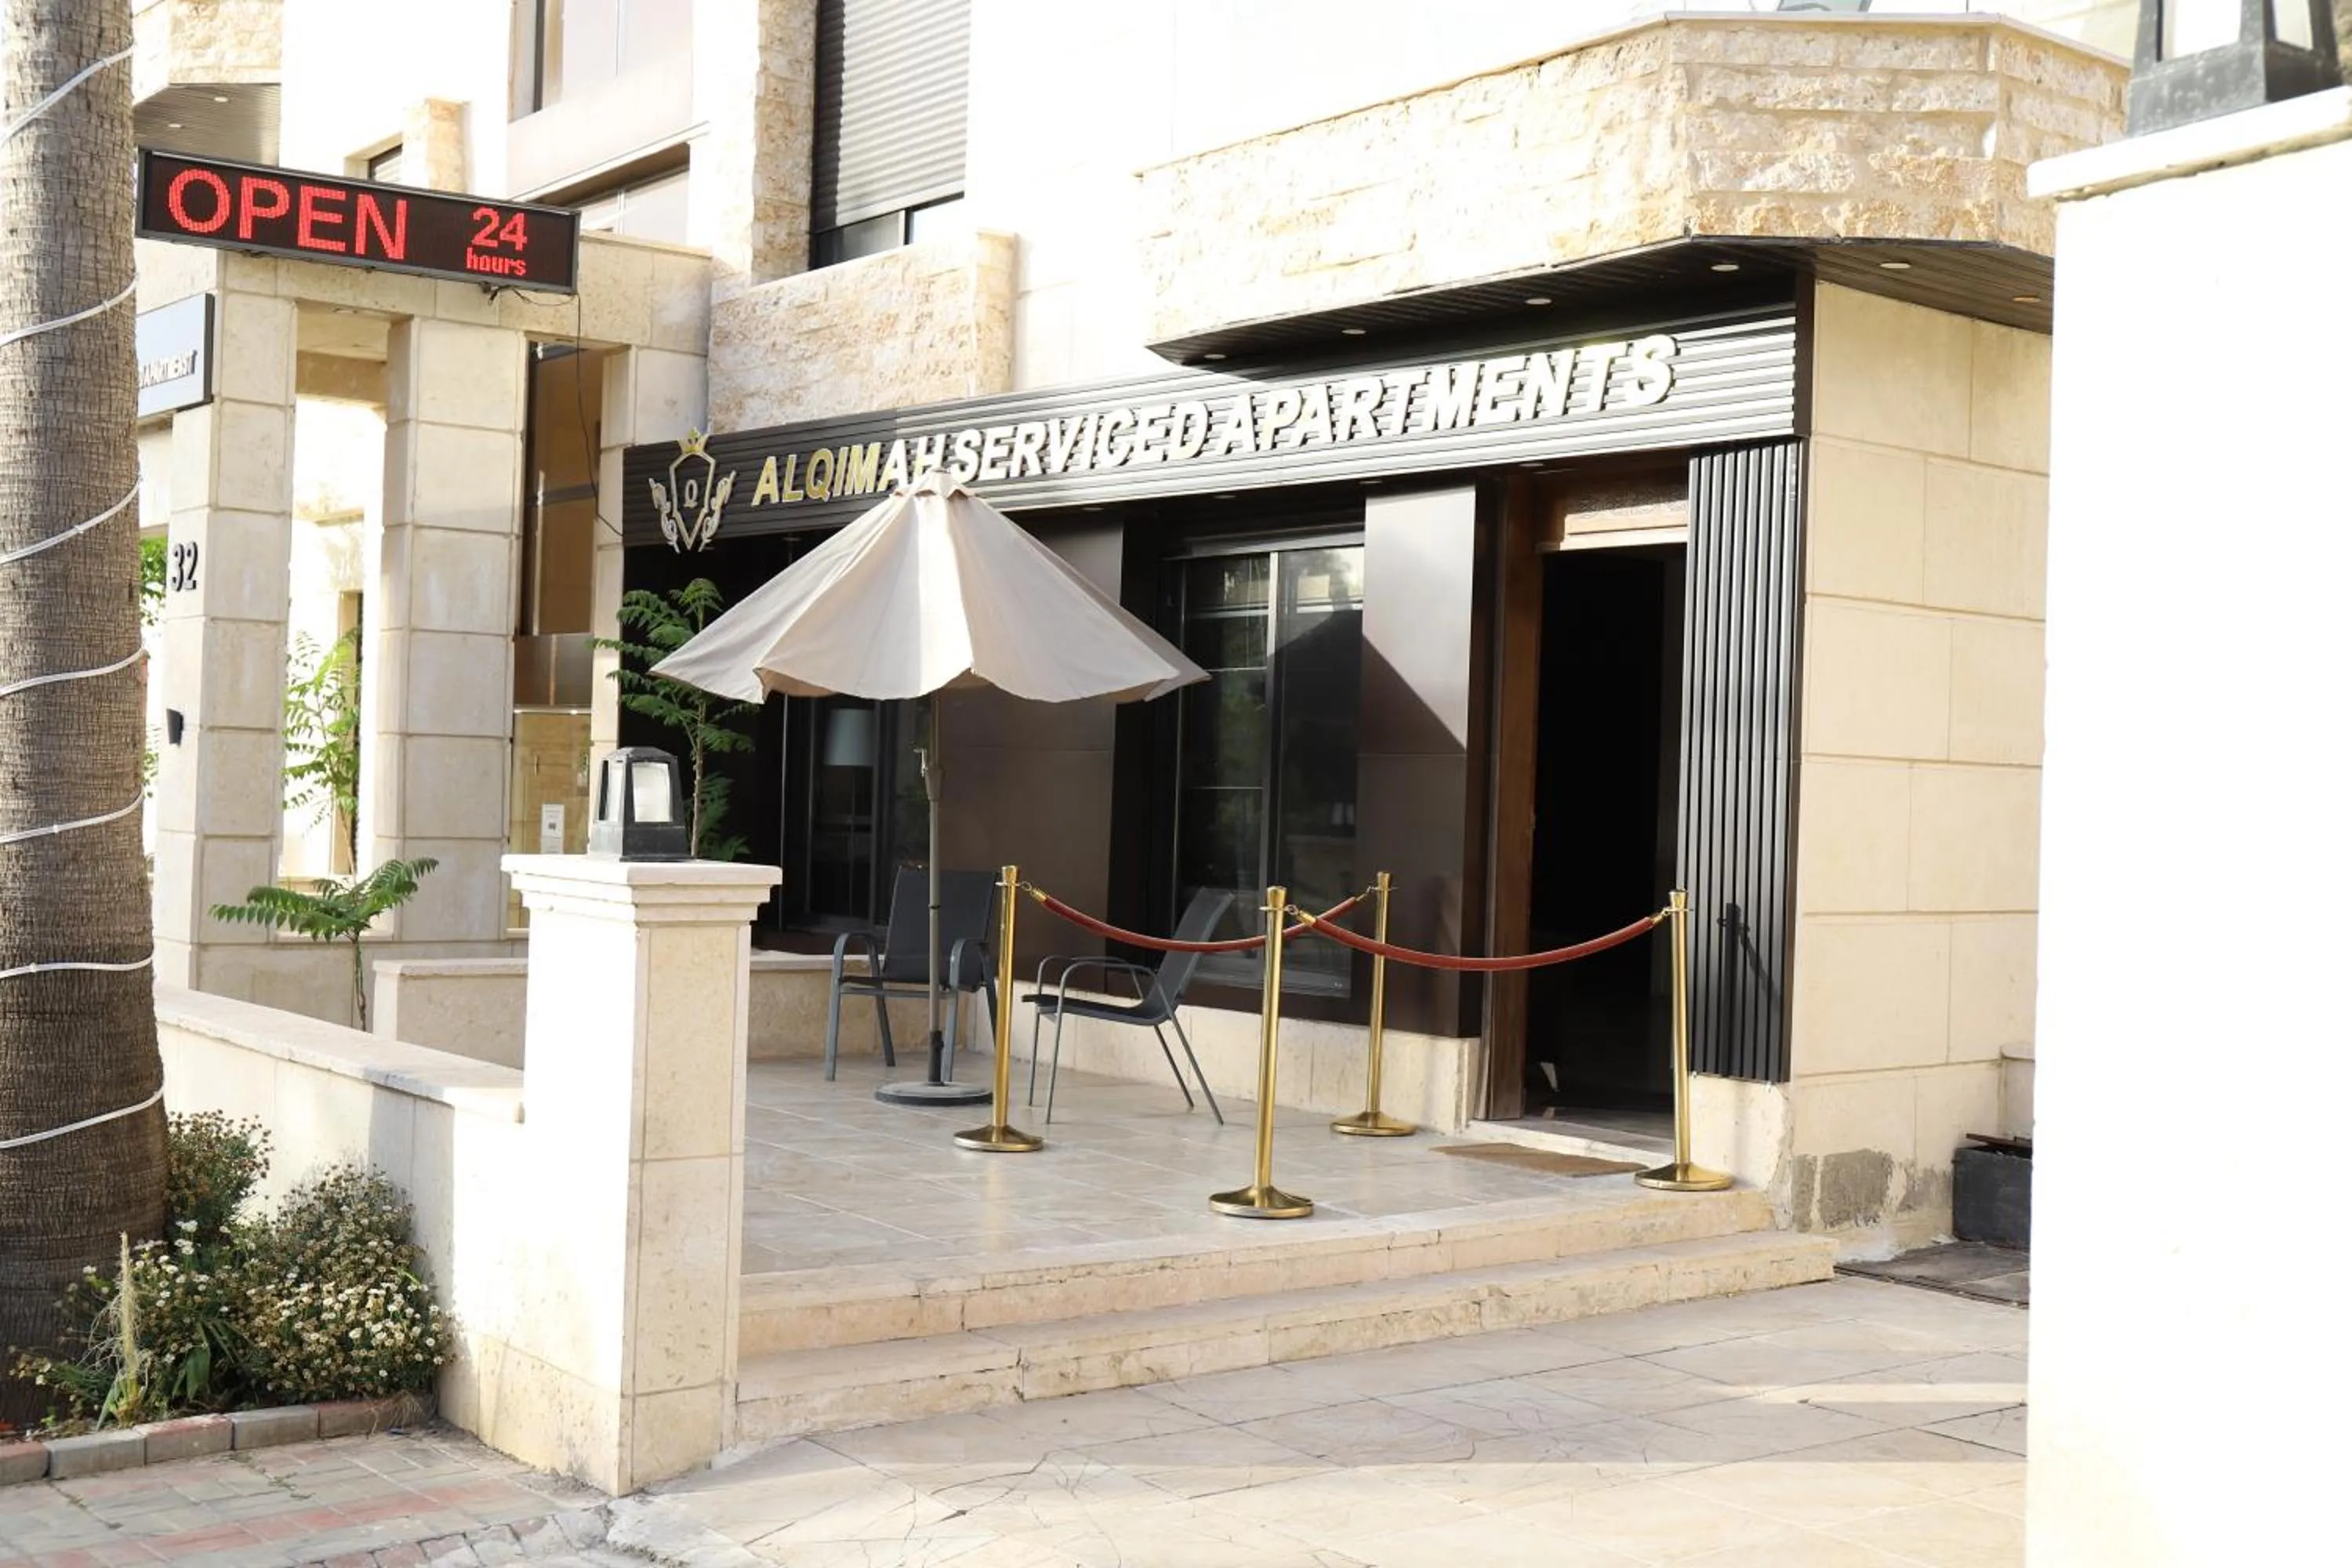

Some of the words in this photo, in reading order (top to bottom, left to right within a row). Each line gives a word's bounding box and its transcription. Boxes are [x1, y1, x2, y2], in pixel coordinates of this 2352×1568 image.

[168, 168, 408, 261] OPEN
[471, 206, 528, 252] 24
[466, 246, 527, 277] hours
[750, 434, 947, 507] ALQIMAH
[949, 400, 1211, 485] SERVICED
[1214, 333, 1679, 457] APARTMENTS
[171, 540, 198, 592] 32
